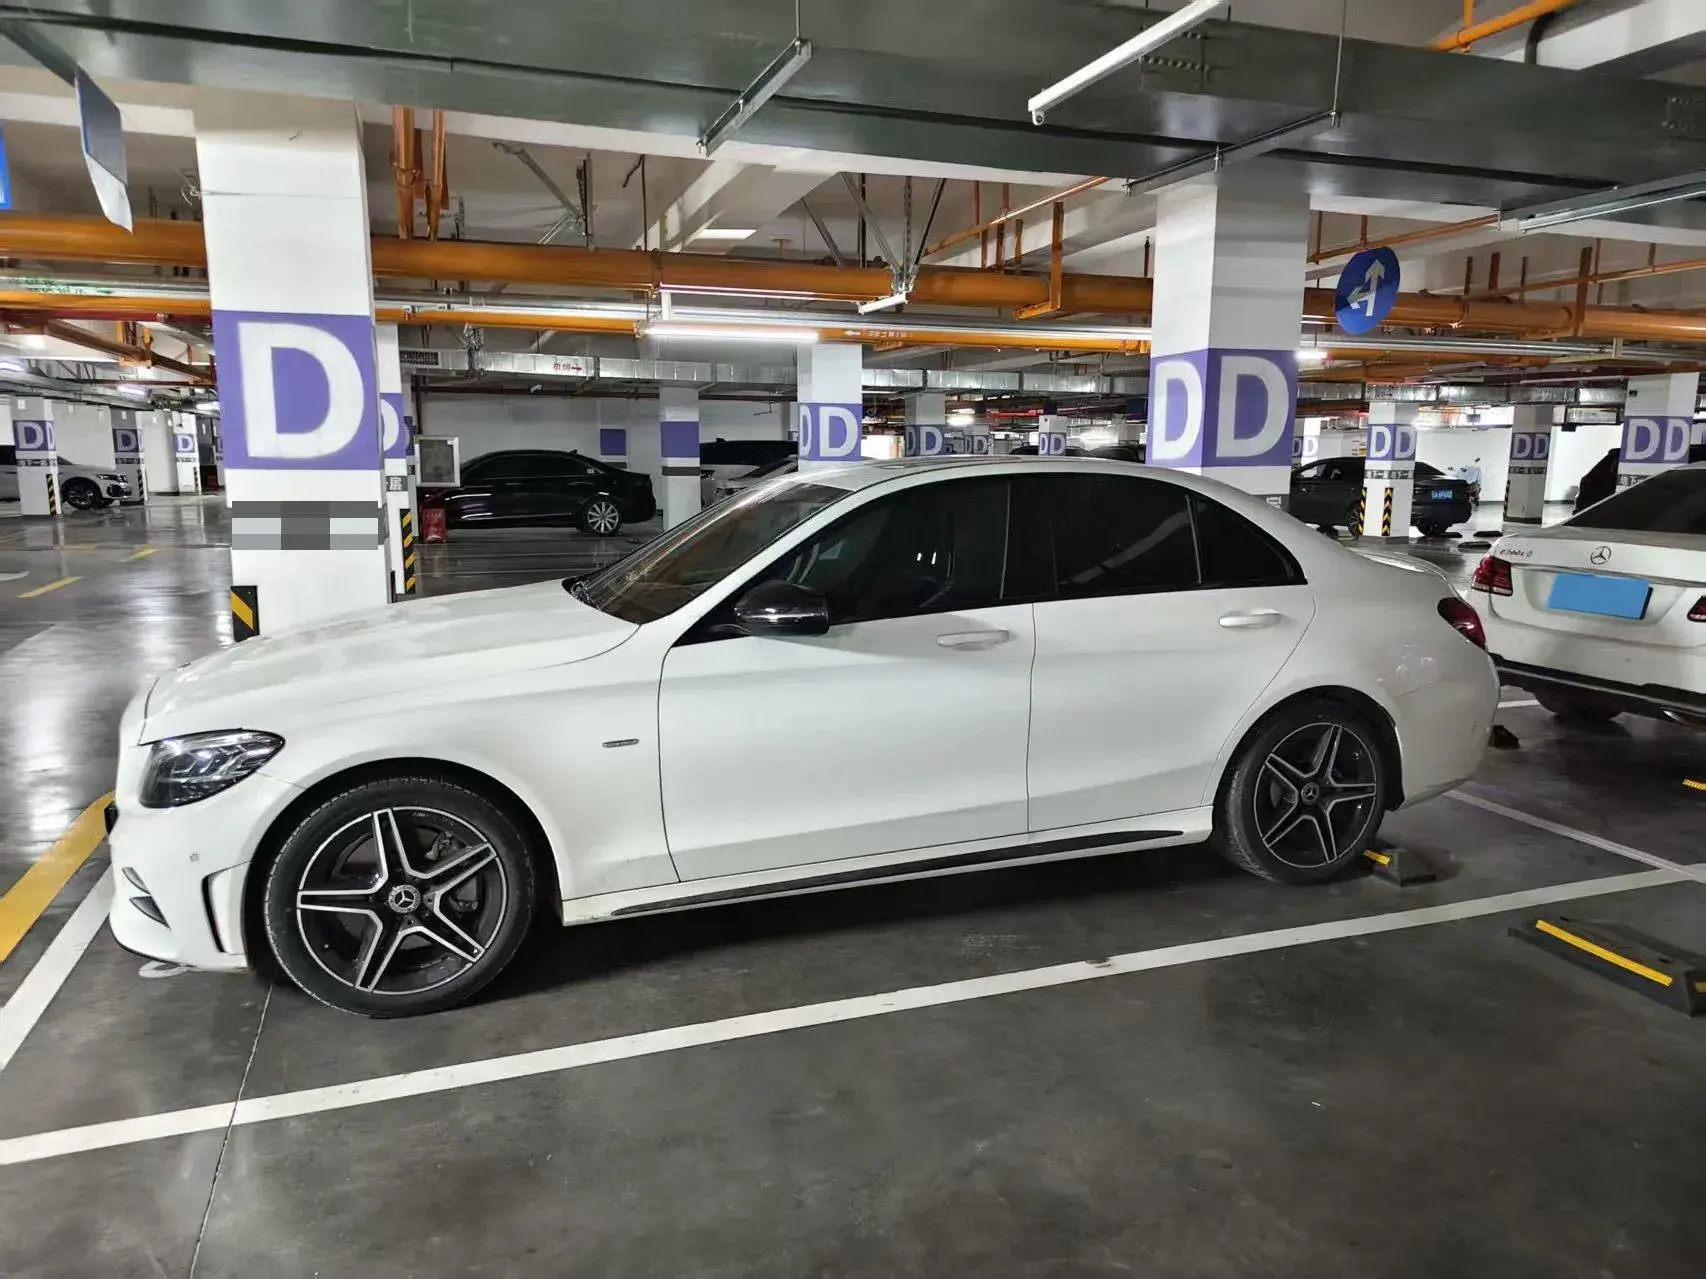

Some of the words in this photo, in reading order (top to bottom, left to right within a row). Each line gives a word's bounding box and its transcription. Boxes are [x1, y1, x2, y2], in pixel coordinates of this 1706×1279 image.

[238, 321, 364, 459] D
[1152, 360, 1201, 460] D
[1216, 355, 1289, 458] D
[18, 421, 43, 449] D
[117, 429, 138, 450] D
[177, 434, 194, 451] D
[800, 405, 811, 458] D
[819, 407, 858, 457] D
[906, 426, 916, 456] D
[920, 426, 943, 455] D
[974, 436, 987, 454] D
[1040, 434, 1048, 454] D
[1051, 434, 1066, 454] D
[1369, 426, 1392, 458] D
[1394, 426, 1417, 459] D
[1625, 419, 1660, 460] D
[1664, 419, 1690, 460] D
[1302, 436, 1319, 457] D
[1512, 434, 1532, 459] D
[1533, 434, 1549, 459] D
